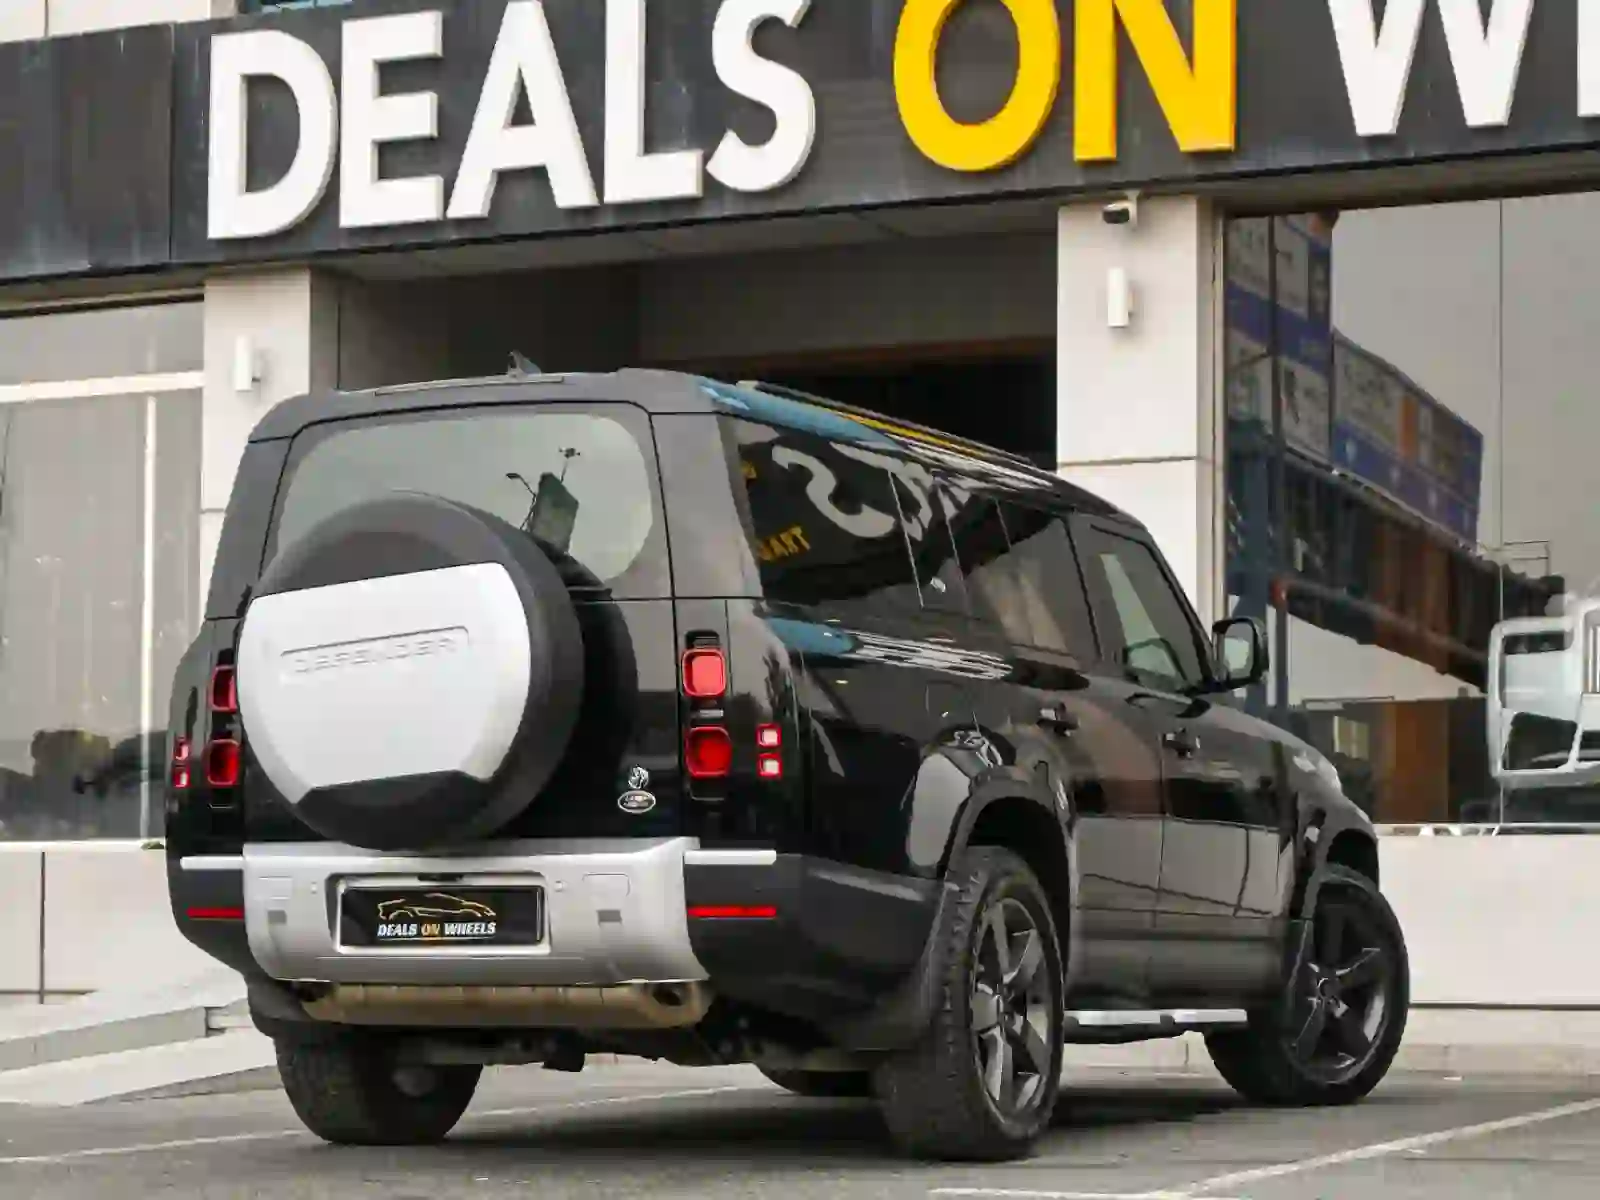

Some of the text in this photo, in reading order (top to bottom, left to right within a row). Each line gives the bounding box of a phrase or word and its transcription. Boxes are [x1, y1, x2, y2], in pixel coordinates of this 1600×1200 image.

[207, 0, 817, 240] DEALS
[893, 0, 1237, 172] ON
[377, 921, 497, 937] DEALS ON WHEELS
